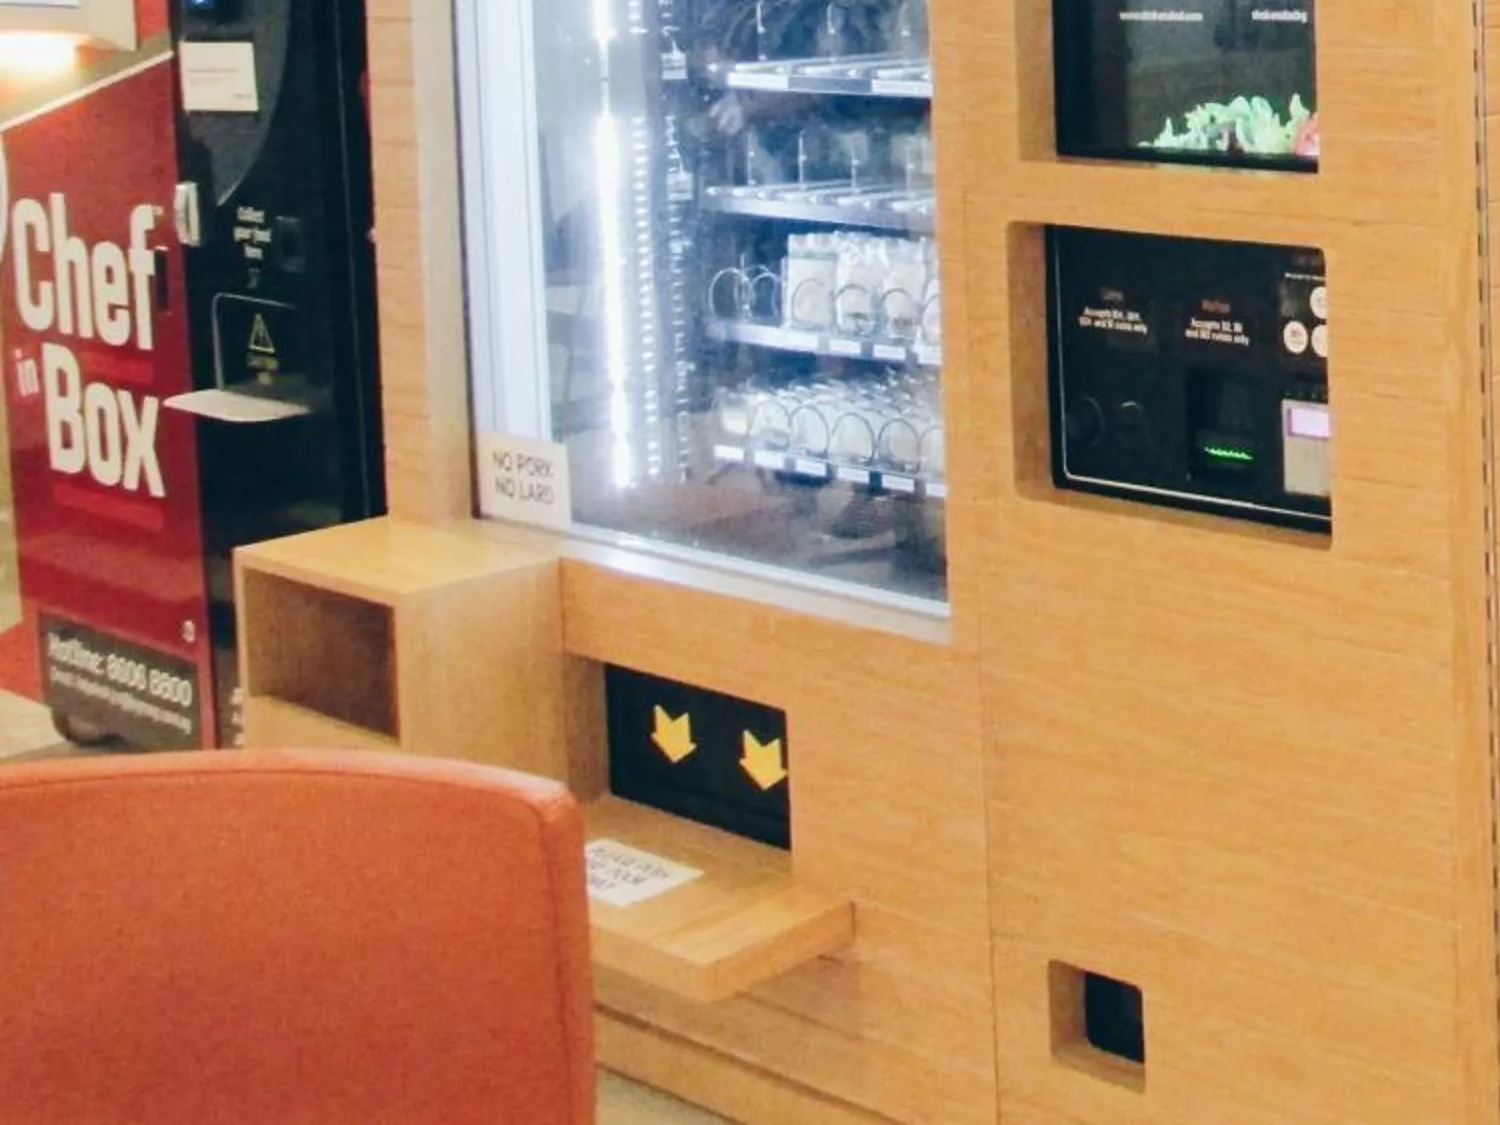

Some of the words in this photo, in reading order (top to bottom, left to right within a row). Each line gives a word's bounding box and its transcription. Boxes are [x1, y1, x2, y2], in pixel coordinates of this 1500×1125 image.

[11, 192, 155, 351] Chef
[15, 350, 40, 398] in
[492, 450, 513, 472] NO
[495, 476, 515, 499] NO
